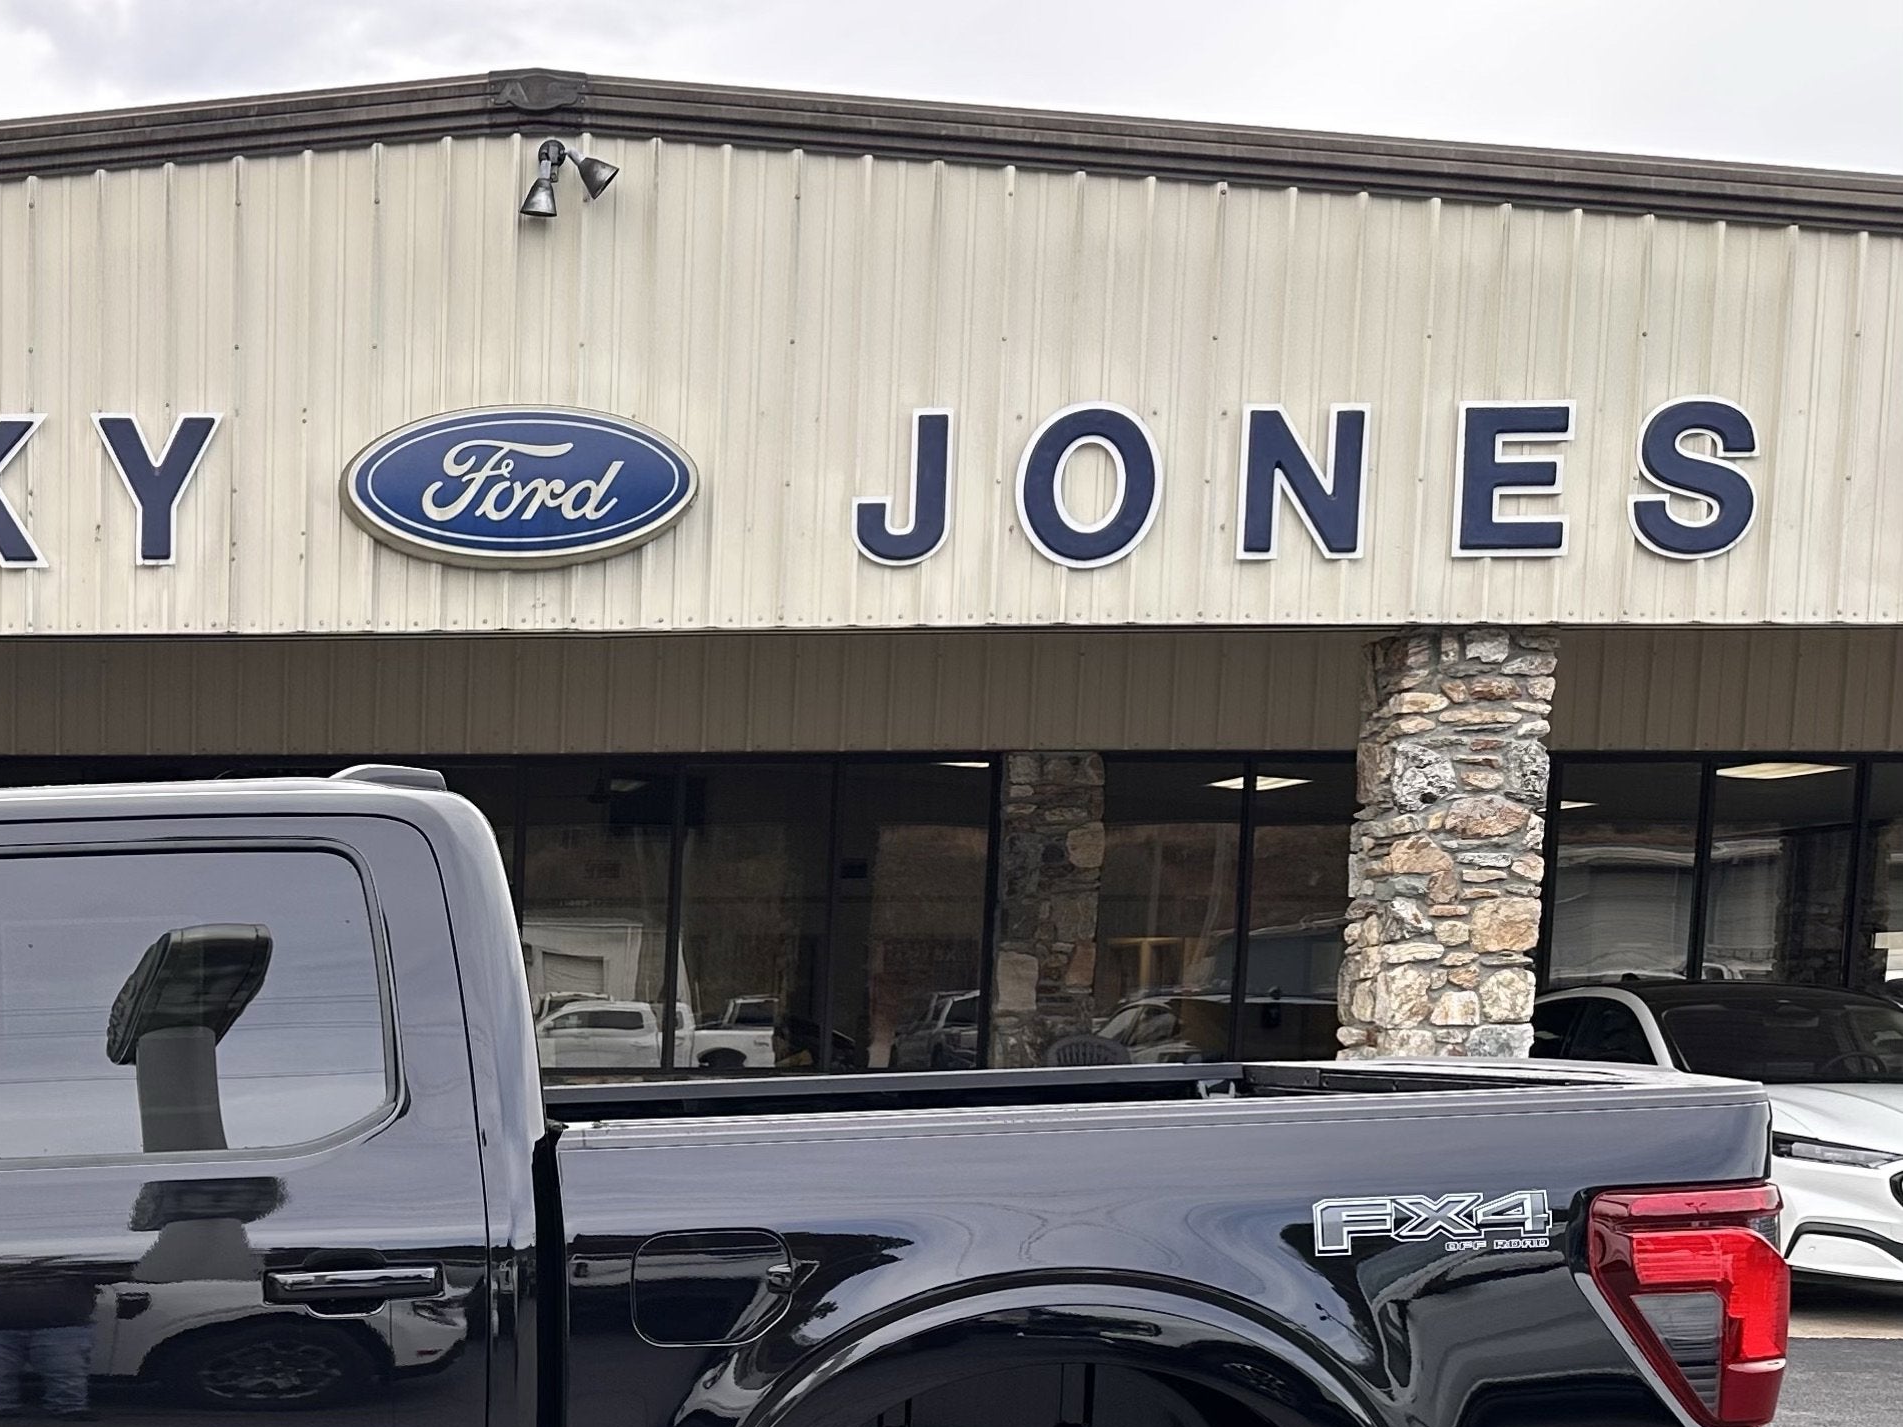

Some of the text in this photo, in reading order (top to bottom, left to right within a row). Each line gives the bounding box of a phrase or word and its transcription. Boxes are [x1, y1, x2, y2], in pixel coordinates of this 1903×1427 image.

[422, 439, 625, 521] Ford
[852, 394, 1761, 567] JONES
[1312, 1190, 1553, 1256] FX4
[1445, 1238, 1550, 1251] OFF ROAD
